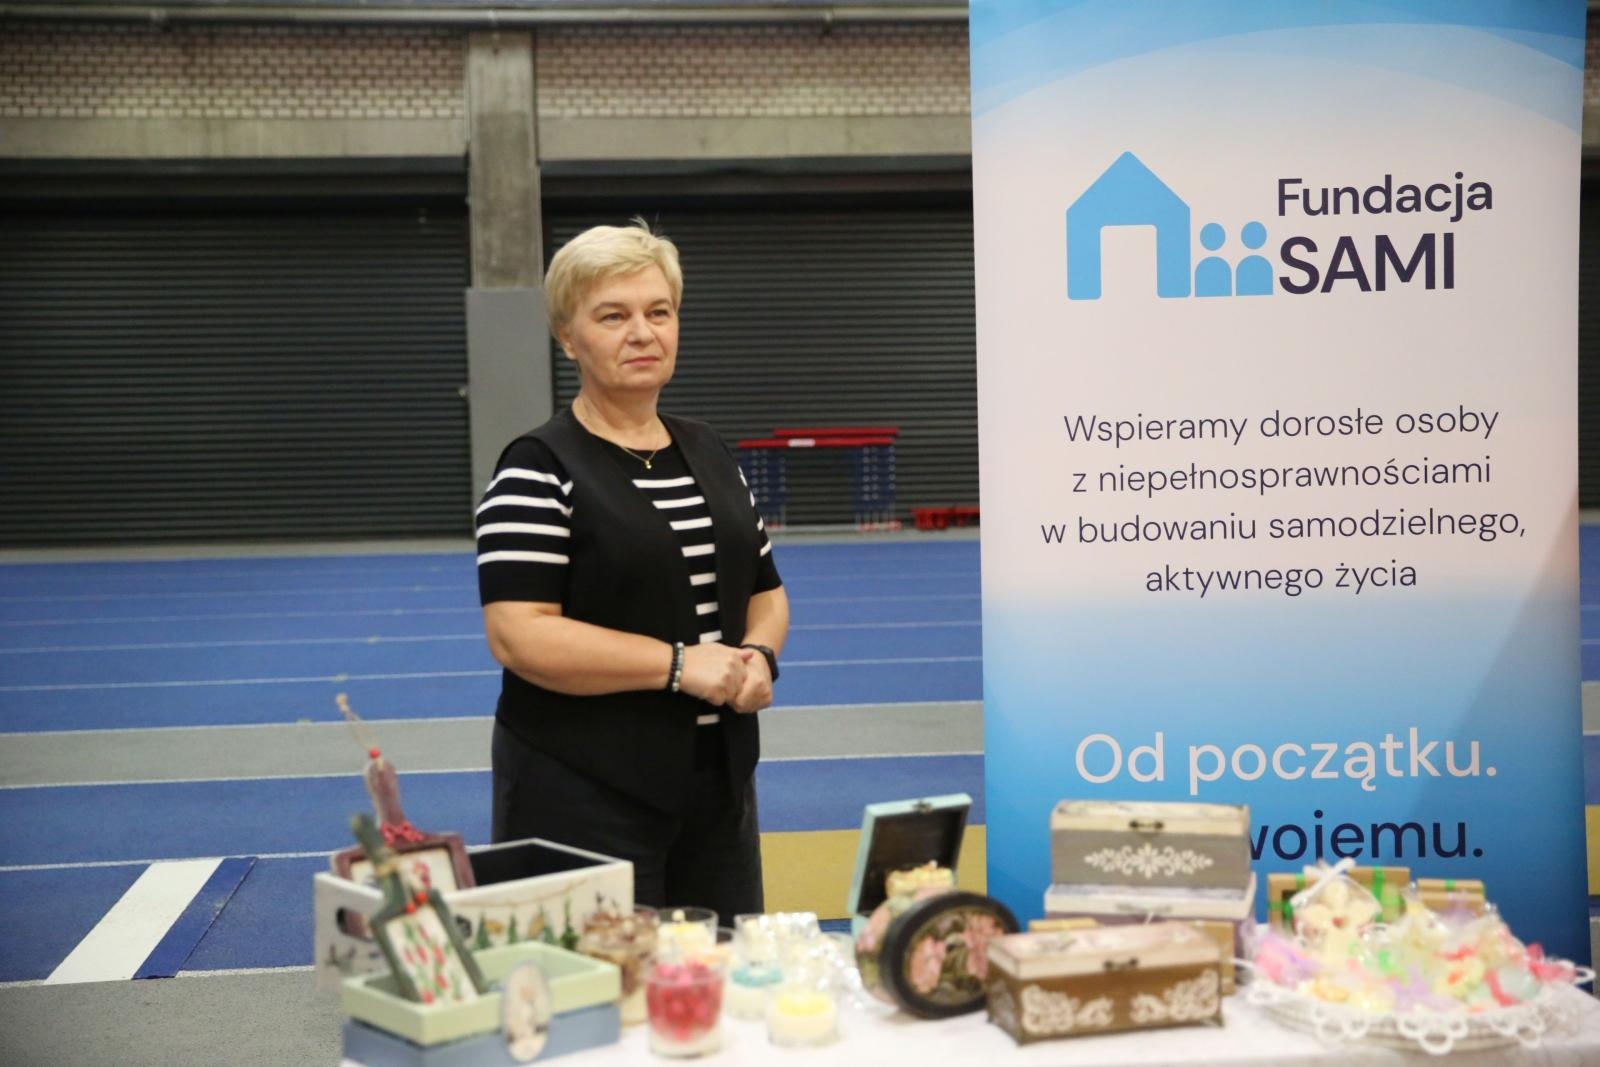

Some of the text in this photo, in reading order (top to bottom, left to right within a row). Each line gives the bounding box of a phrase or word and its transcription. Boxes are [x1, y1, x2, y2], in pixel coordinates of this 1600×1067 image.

[1277, 171, 1493, 222] Fundacja
[1278, 232, 1455, 295] SAMI
[1064, 405, 1499, 448] Wspieramy dorosłe osoby
[1072, 455, 1491, 498] z niepełnosprawnościami
[1041, 508, 1526, 545] w budowaniu samodzielnego,
[1146, 559, 1418, 598] aktywnego życia
[1075, 727, 1497, 796] Od początku.
